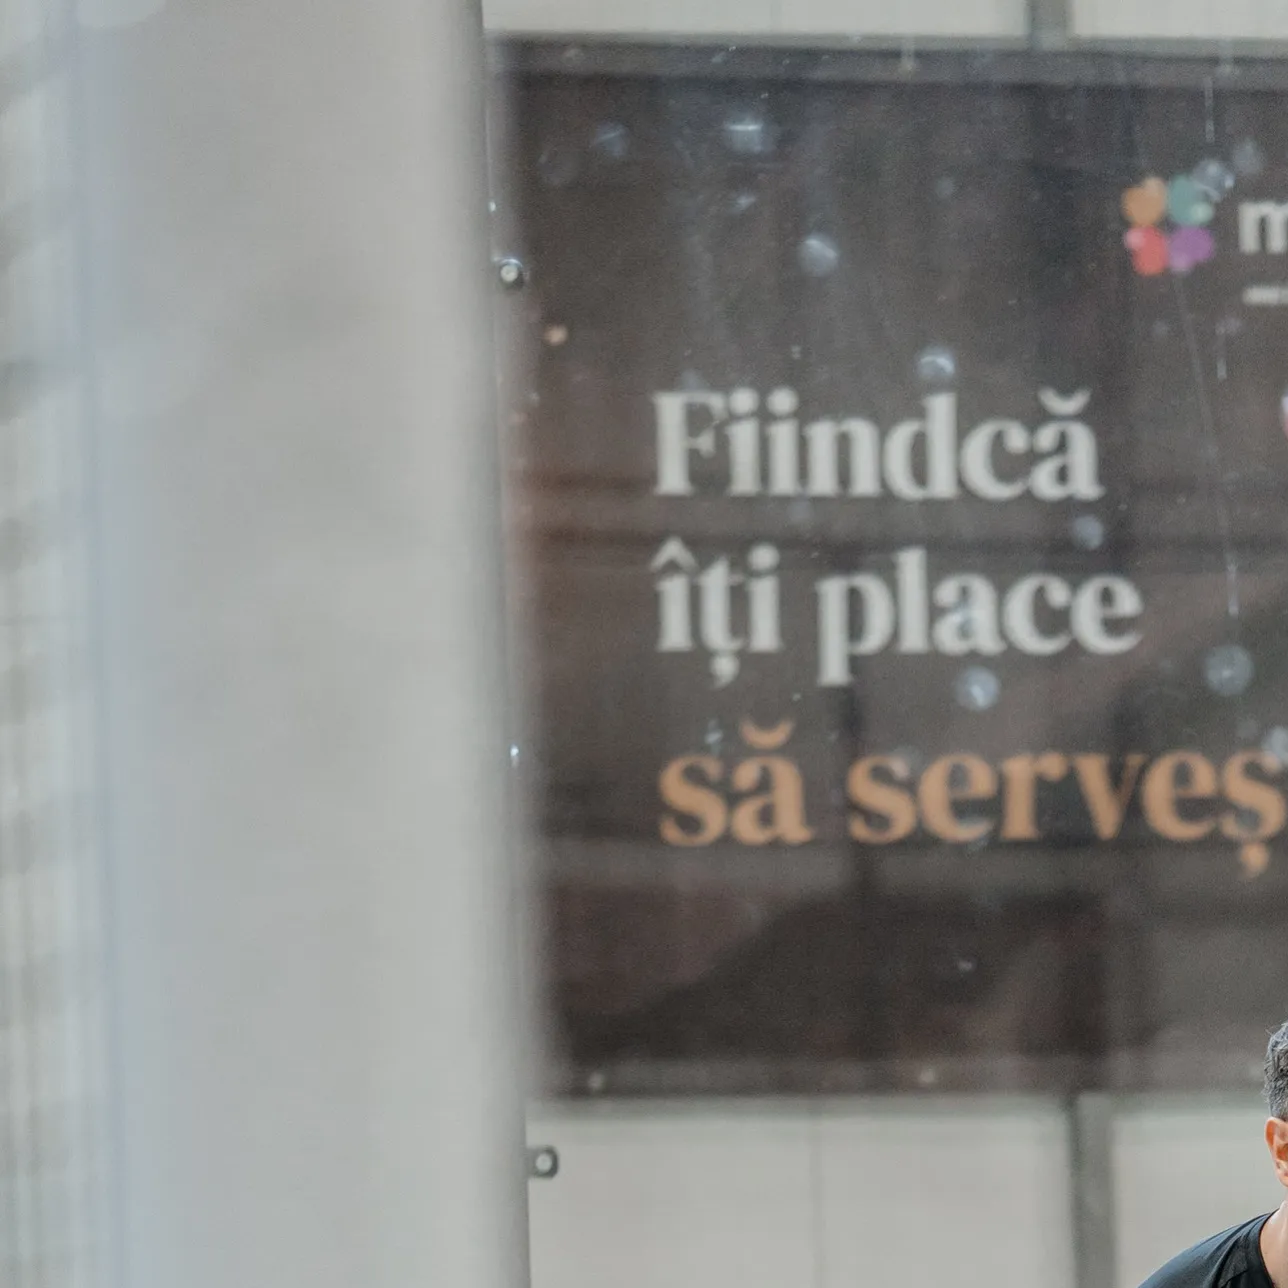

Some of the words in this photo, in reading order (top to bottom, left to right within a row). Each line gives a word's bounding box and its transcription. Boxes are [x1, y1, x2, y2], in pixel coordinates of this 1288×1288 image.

[652, 386, 1105, 501] Fiindcă
[815, 545, 1144, 688] place
[658, 716, 815, 847] să
